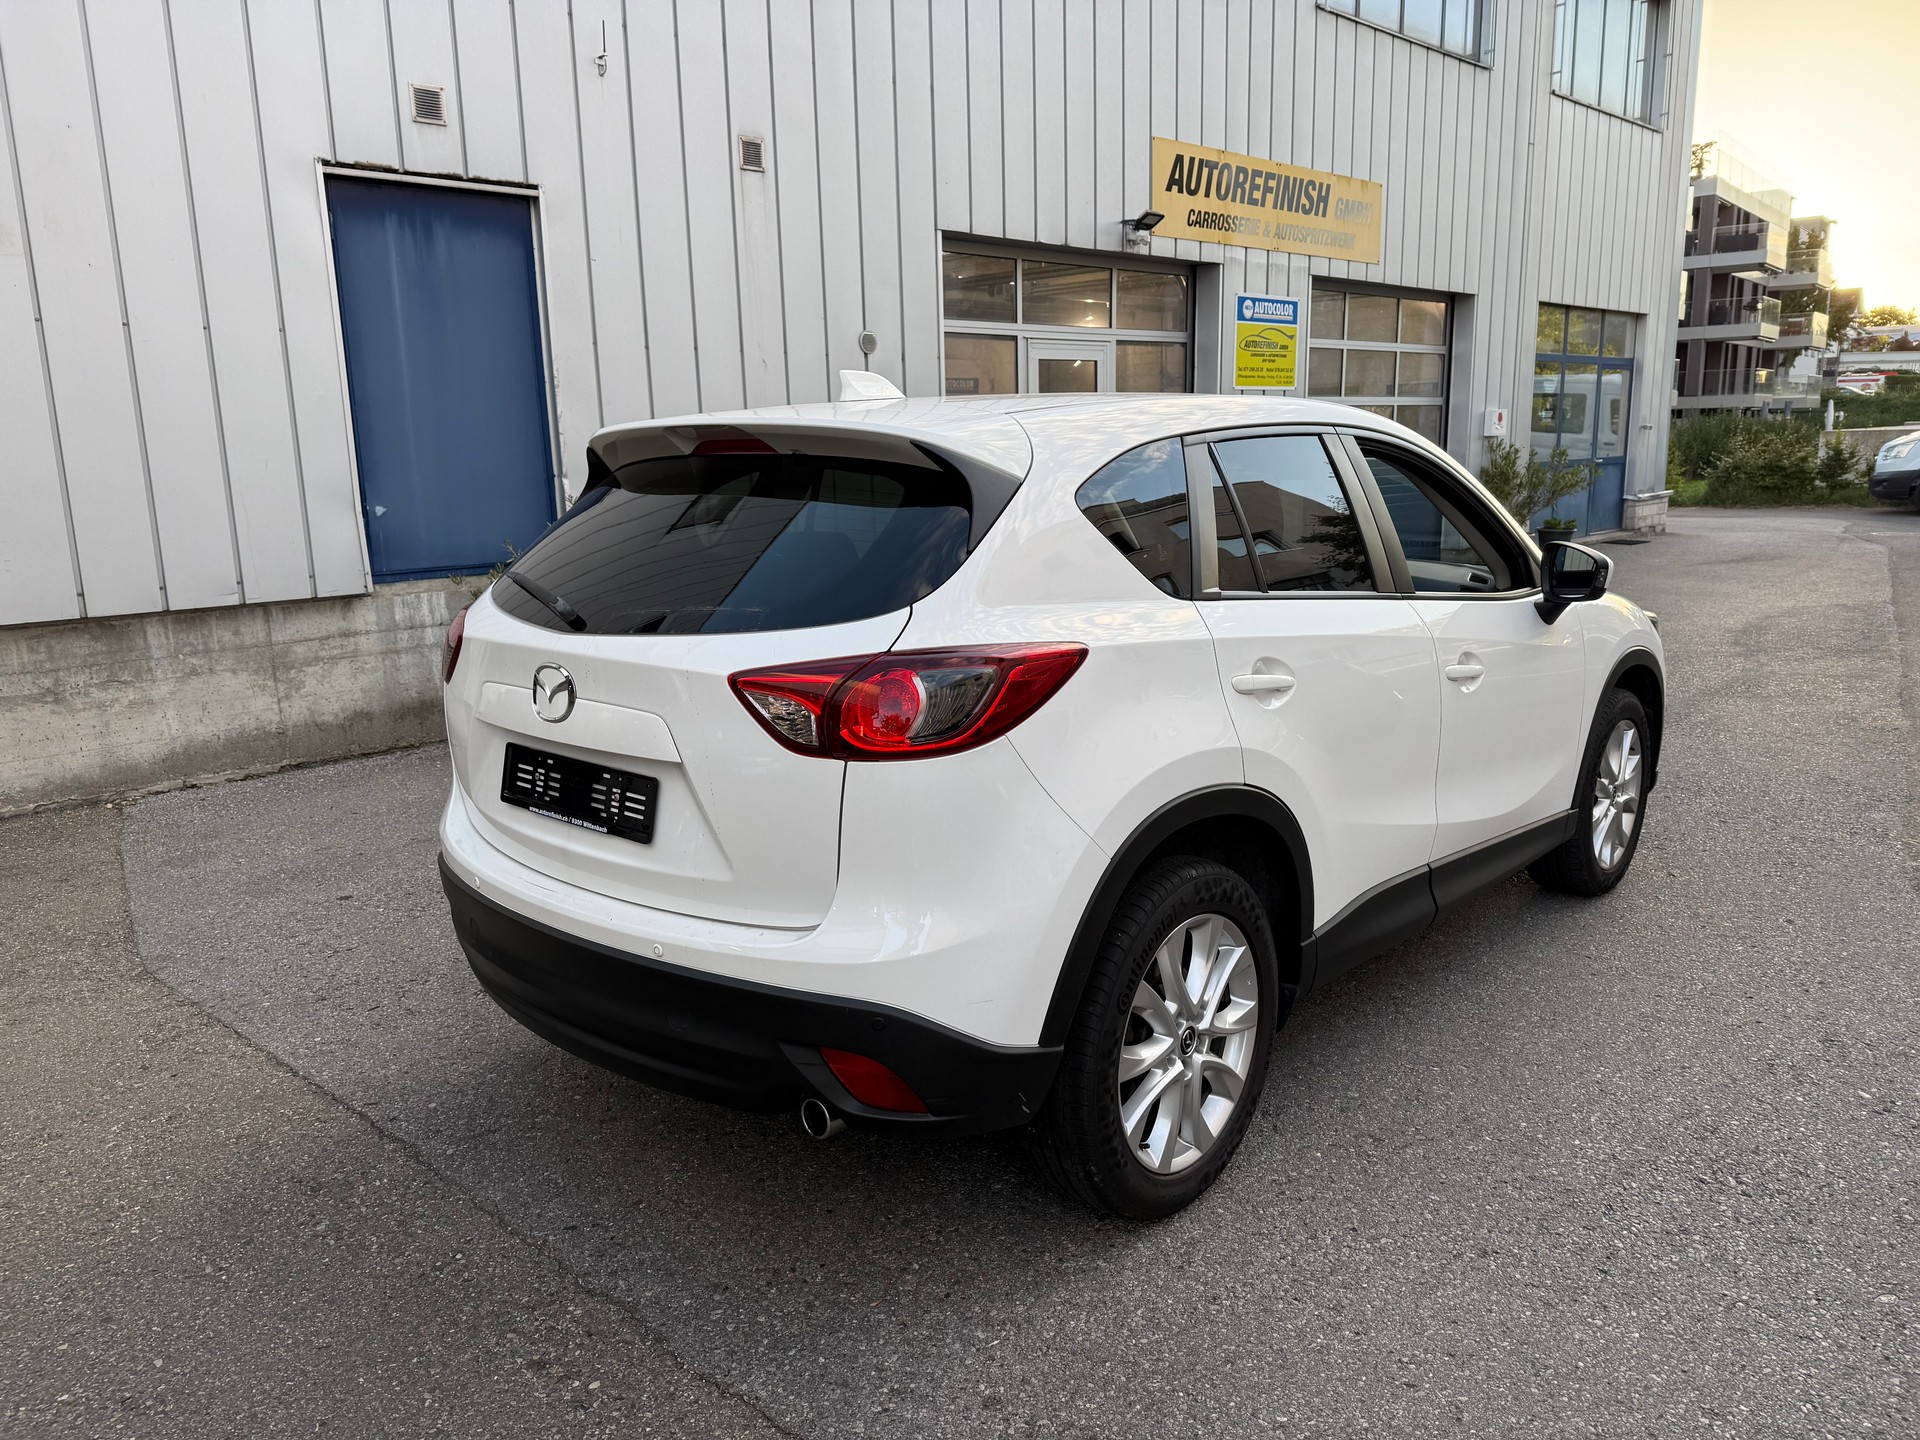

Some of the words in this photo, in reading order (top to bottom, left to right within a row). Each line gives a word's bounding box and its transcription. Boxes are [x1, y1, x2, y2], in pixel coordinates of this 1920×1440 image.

[1164, 153, 1332, 218] AUTOREFINISH
[1187, 208, 1260, 235] CARROSSERIE
[1263, 221, 1272, 238] &
[1254, 301, 1294, 316] AUTOCOLOR
[582, 820, 608, 833] Wittenbach
